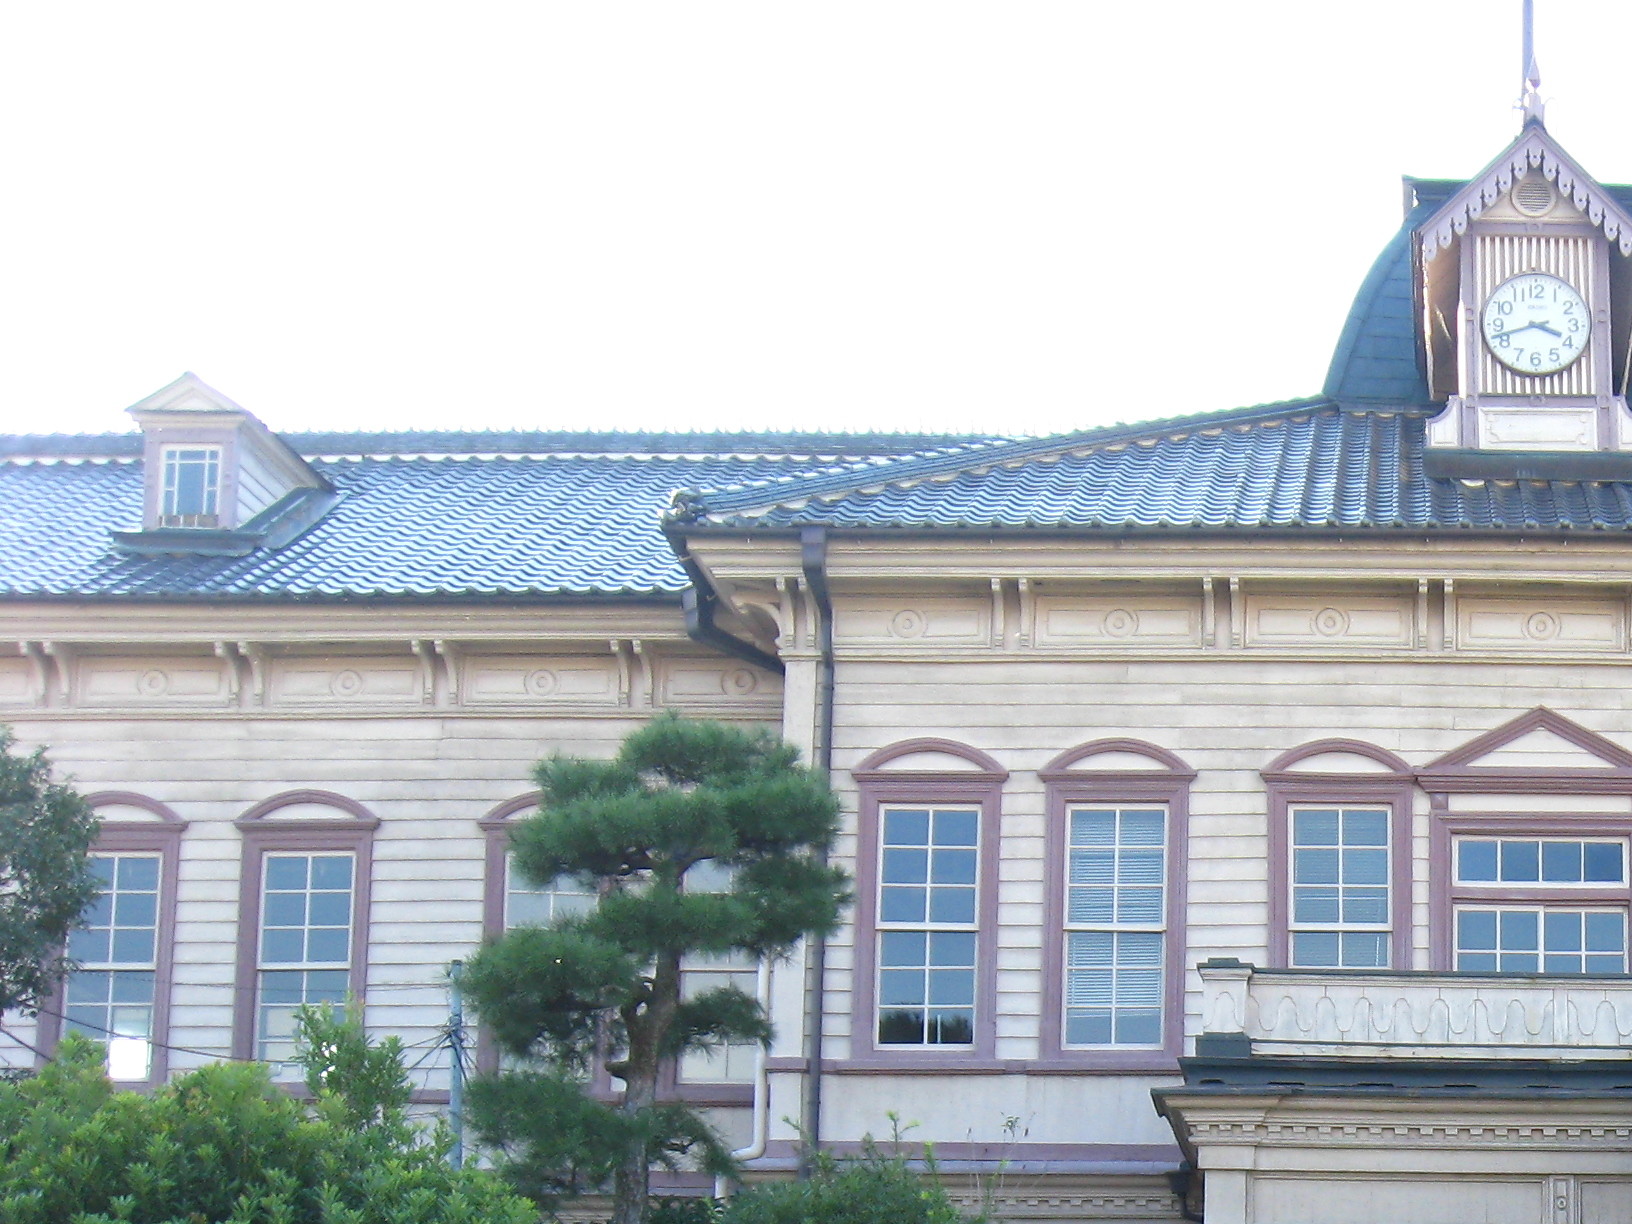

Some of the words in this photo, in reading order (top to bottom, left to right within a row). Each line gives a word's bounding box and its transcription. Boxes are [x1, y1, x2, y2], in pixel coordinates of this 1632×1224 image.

[1513, 288, 1525, 302] 11
[1529, 284, 1544, 299] 12
[1497, 301, 1513, 315] 10
[1563, 301, 1574, 315] 2
[1492, 318, 1504, 332] 9
[1568, 318, 1579, 333] 3
[1499, 333, 1511, 348] 8
[1562, 335, 1574, 349] 4
[1514, 348, 1525, 362] 7
[1530, 352, 1541, 367] 6
[1549, 348, 1560, 362] 5
